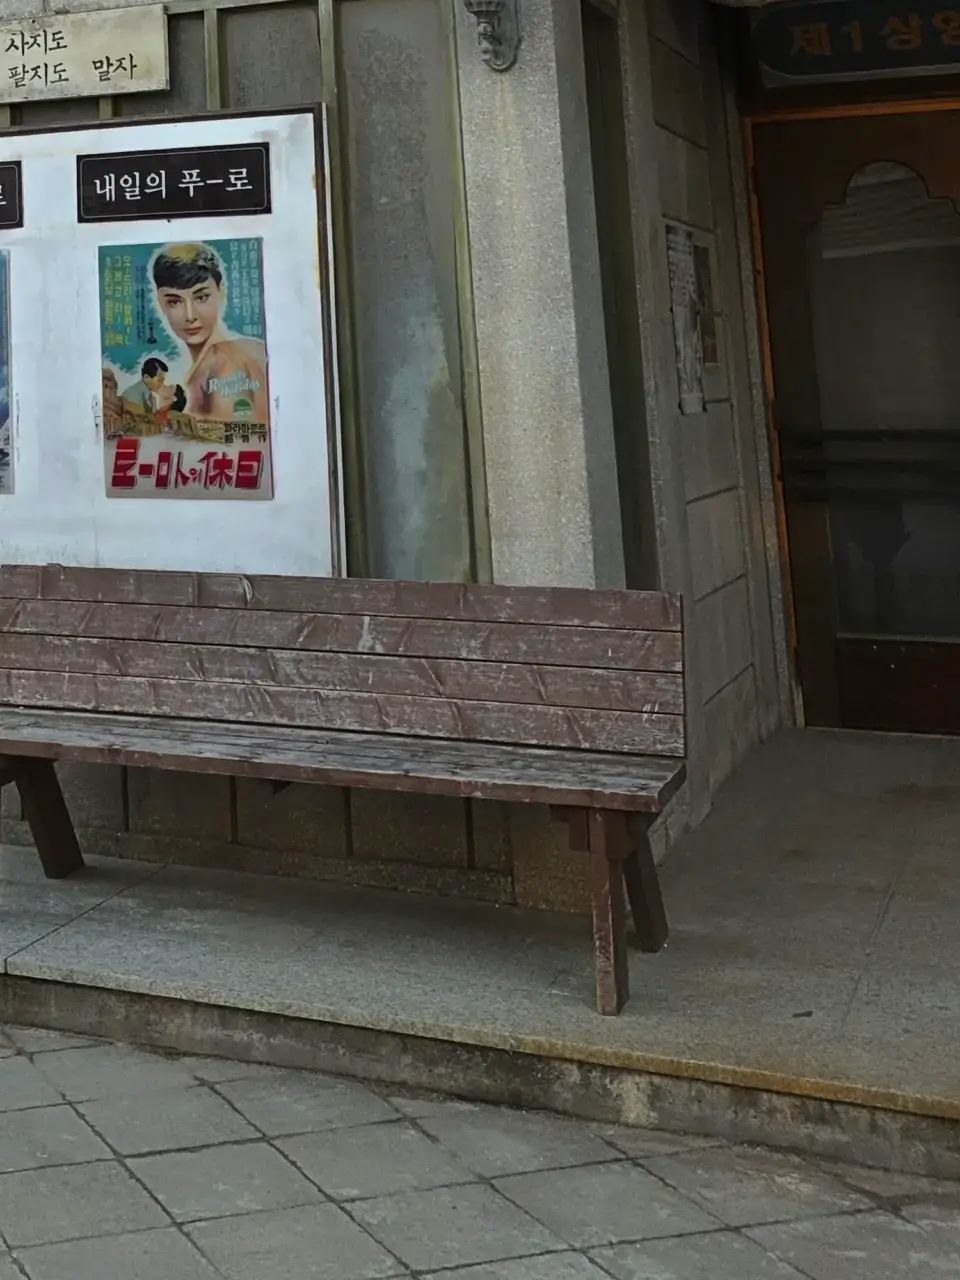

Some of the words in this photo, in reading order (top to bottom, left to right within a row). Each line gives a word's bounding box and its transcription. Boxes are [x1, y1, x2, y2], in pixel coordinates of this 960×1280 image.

[5, 29, 68, 56] 사지도
[8, 62, 70, 88] 팔지도
[92, 53, 137, 81] 말자
[94, 169, 167, 202] 내일의
